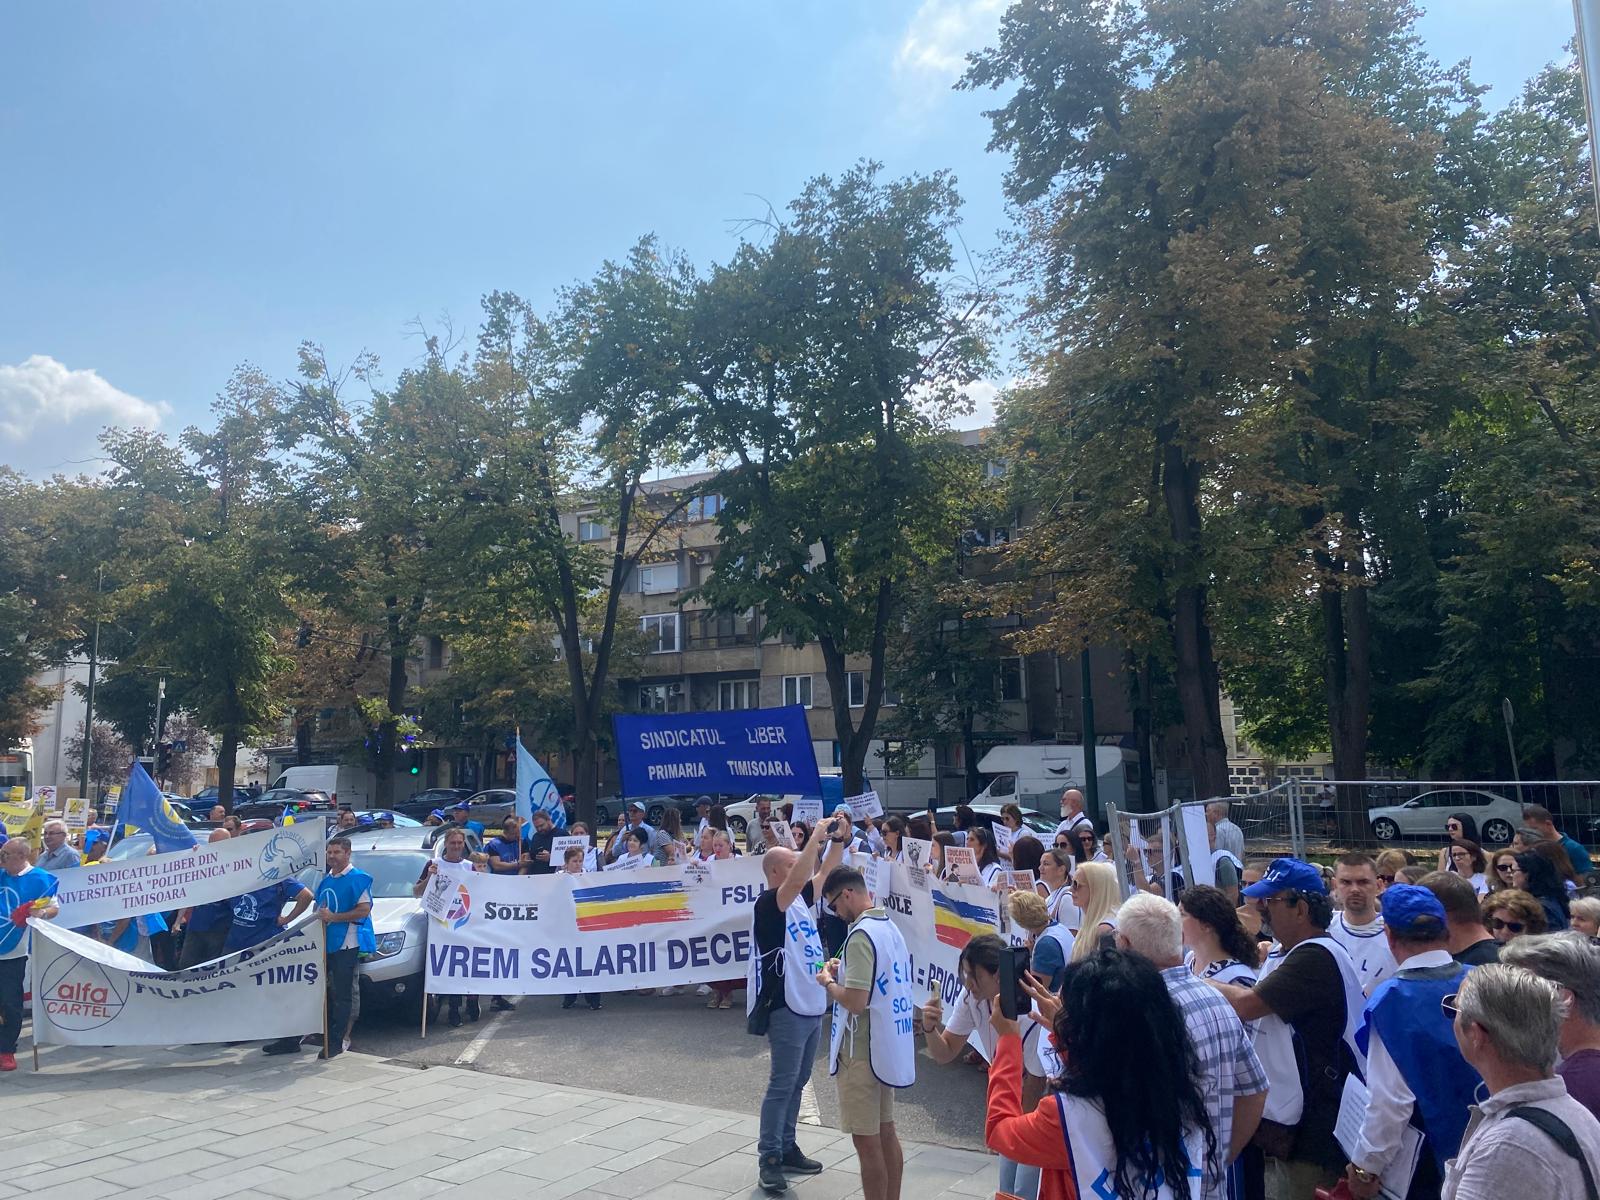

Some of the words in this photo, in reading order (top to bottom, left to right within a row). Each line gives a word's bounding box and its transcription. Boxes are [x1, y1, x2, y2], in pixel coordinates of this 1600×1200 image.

[640, 728, 726, 750] SINDICATUL
[746, 726, 786, 744] LIBER
[648, 762, 706, 780] PRIMARIA
[726, 760, 794, 776] TIMISOARA
[88, 865, 160, 886] SINDICATUL
[163, 857, 195, 874] LIBER
[198, 852, 218, 866] DIN
[58, 882, 143, 904] NIVERSITATEA
[147, 864, 230, 889] "POLITEHNICA"
[233, 858, 252, 872] DIN
[122, 888, 187, 909] TIMISOARA
[484, 902, 538, 921] SOLE
[430, 944, 519, 978] VREM
[531, 942, 656, 978] SALARII
[668, 930, 750, 970] DECE
[58, 982, 108, 1003] alfa
[927, 962, 962, 1006] PRIOR
[47, 1002, 111, 1018] CARTEL
[894, 1018, 912, 1036] TIM
